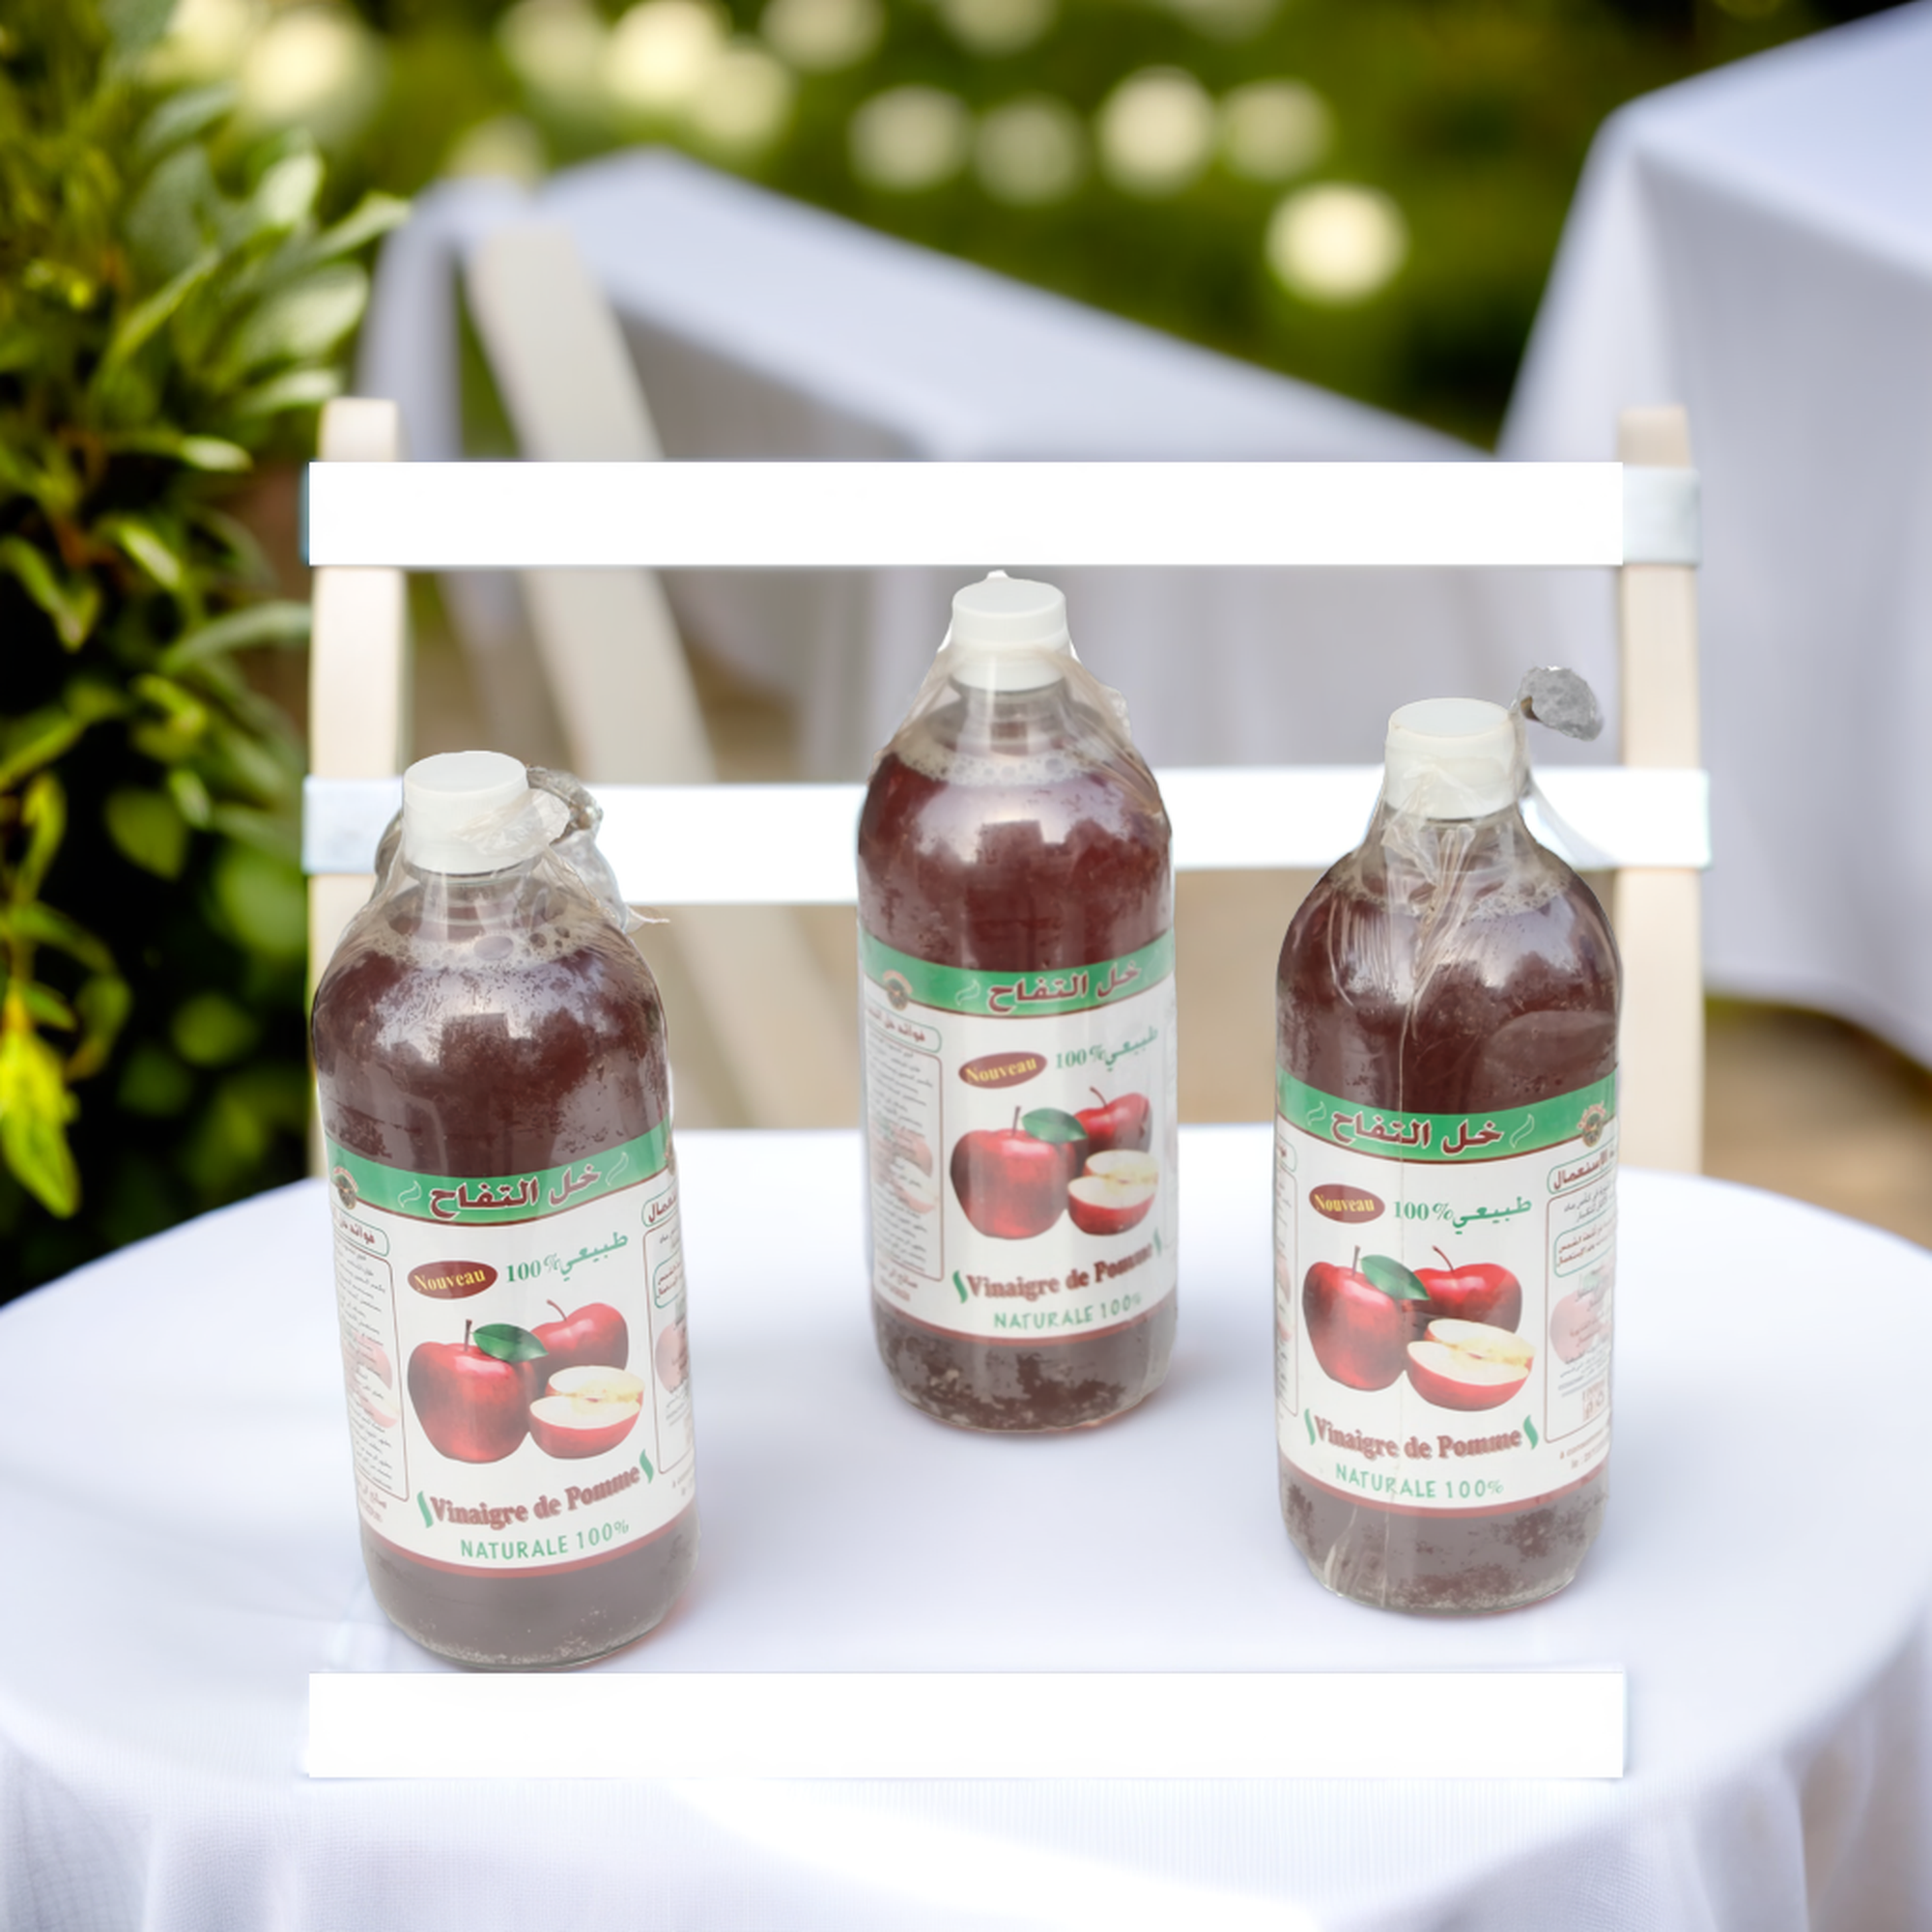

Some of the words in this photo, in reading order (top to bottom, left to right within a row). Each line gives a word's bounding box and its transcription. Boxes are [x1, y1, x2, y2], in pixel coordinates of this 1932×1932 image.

[988, 972, 1089, 1014] التفاح
[1097, 960, 1142, 998] خل
[966, 1056, 1037, 1084] Nouveau
[1331, 1110, 1433, 1148] التفاح
[1441, 1121, 1504, 1155] خل
[430, 1178, 539, 1220] التفاح
[549, 1164, 602, 1206] خل
[1314, 1193, 1375, 1212] Nouveau
[413, 1269, 486, 1293] Nouveau
[966, 1274, 1061, 1302] Vinaigre
[1065, 1269, 1090, 1291] de
[994, 1305, 1094, 1330] NATURALE
[1314, 1415, 1398, 1461] Vinaigre
[1404, 1436, 1432, 1460] de
[1436, 1430, 1522, 1459] Pomme
[430, 1496, 528, 1531] Vinaigre
[533, 1495, 561, 1520] de
[565, 1465, 640, 1511] Pomme
[1336, 1463, 1436, 1497] NATURALE
[1447, 1479, 1504, 1498] 100%
[461, 1535, 569, 1560] NATURALE
[577, 1519, 629, 1549] 100%
